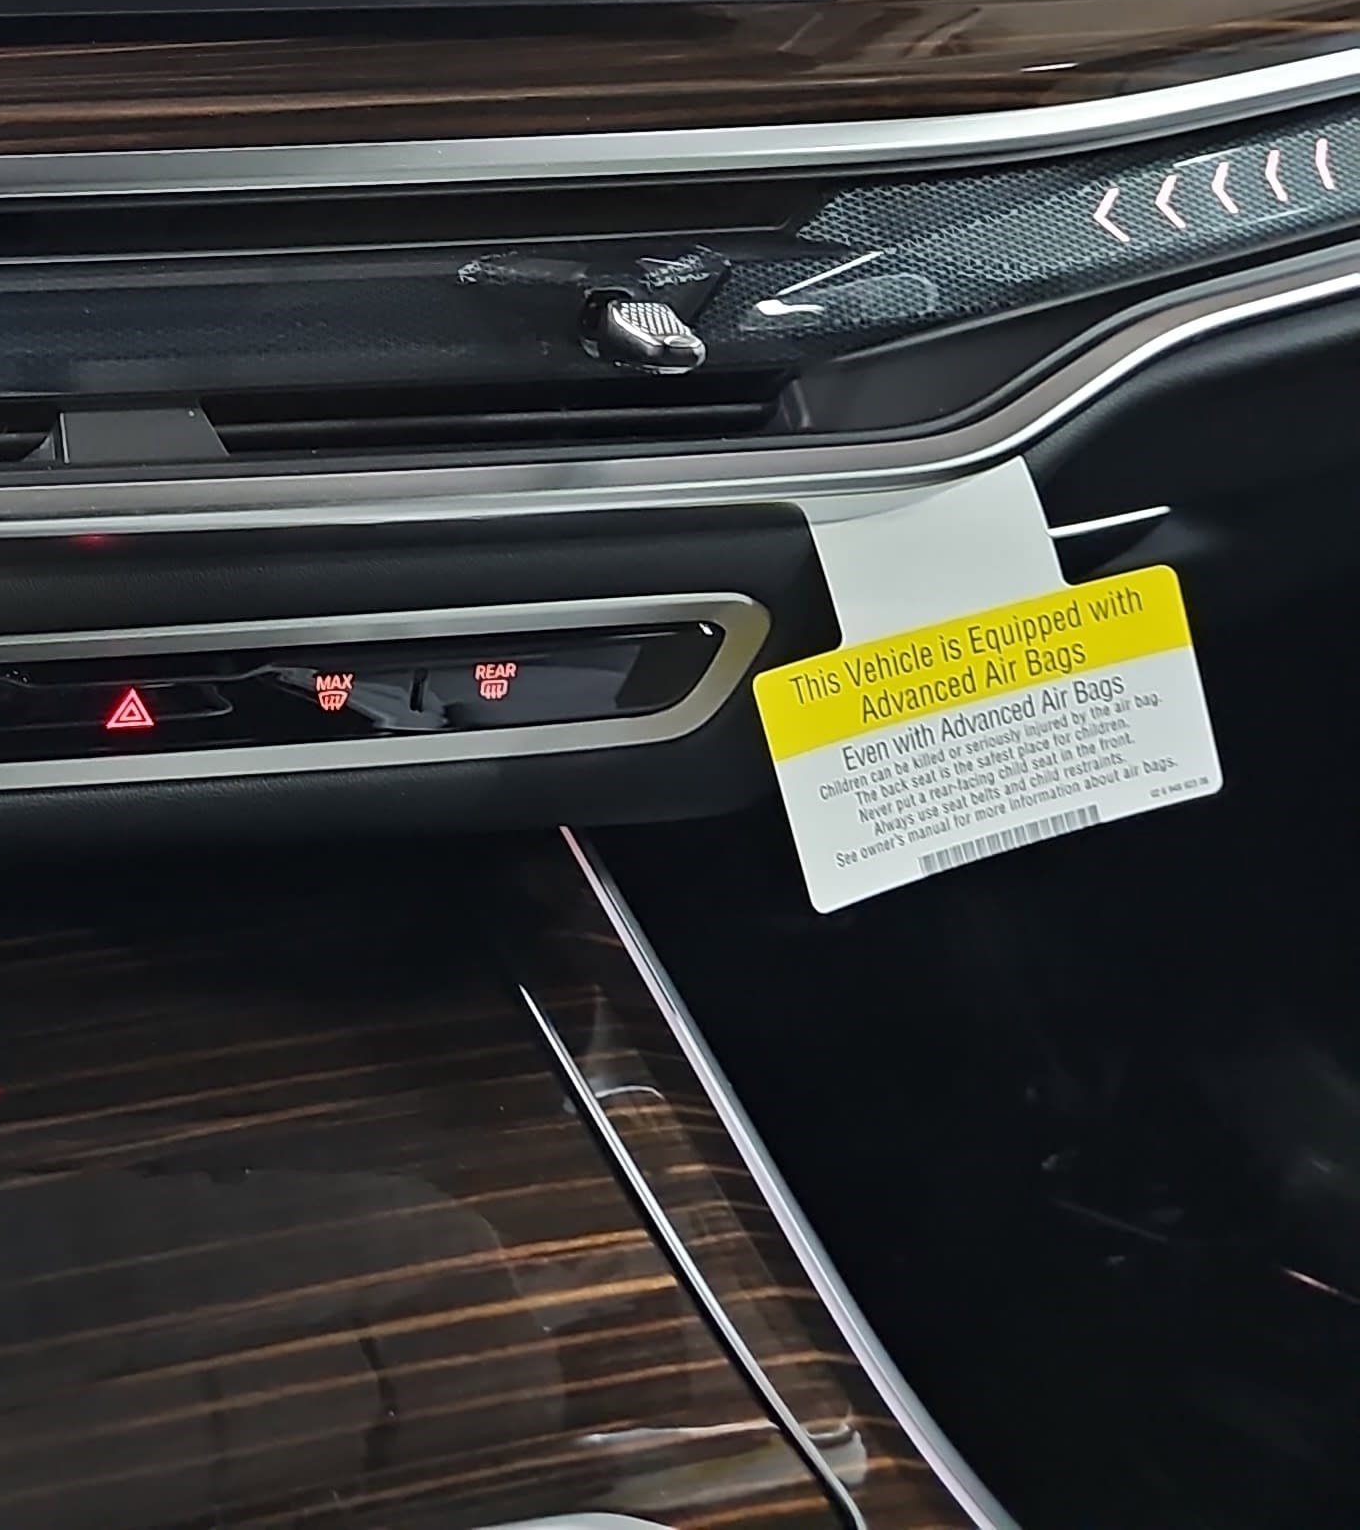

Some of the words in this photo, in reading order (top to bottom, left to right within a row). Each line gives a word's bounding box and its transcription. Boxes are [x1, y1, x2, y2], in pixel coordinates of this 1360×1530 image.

[316, 674, 353, 691] MAX
[476, 663, 517, 680] REAR
[789, 669, 841, 704] This
[844, 643, 933, 687] Vehicle
[939, 635, 962, 662] is
[967, 599, 1082, 654] Equipped
[1087, 587, 1143, 622] with
[862, 665, 976, 723] Advanced
[986, 657, 1016, 688] Air
[1024, 643, 1086, 676] Bags
[819, 775, 868, 800] Children
[870, 767, 892, 783] can
[894, 762, 909, 775] be
[912, 749, 945, 769] killed
[948, 746, 961, 759] or
[965, 728, 1020, 755] seriously
[1023, 713, 1068, 737] injured
[1070, 711, 1086, 725] by
[1089, 705, 1110, 719] the
[1115, 700, 1130, 713] air
[1134, 693, 1162, 708] bag.
[842, 741, 890, 771] Even
[892, 723, 935, 755] with
[941, 693, 1036, 742] Advanced
[1042, 687, 1067, 714] Air
[1073, 676, 1124, 704] Bags
[854, 789, 877, 805] The
[879, 778, 909, 798] back
[911, 769, 937, 788] seat
[940, 767, 951, 779] is
[953, 760, 973, 775] the
[976, 747, 1015, 768] safest
[1017, 739, 1050, 760] place
[1052, 733, 1071, 746] for
[1074, 718, 1130, 741] children.
[836, 851, 857, 867] See
[860, 833, 905, 859] owner's
[905, 817, 951, 843] manual
[953, 813, 970, 828] for
[974, 803, 1005, 821] more
[1008, 781, 1081, 811] information
[1084, 769, 1120, 790] about
[1123, 765, 1138, 779] air
[1142, 757, 1178, 774] bags.
[858, 802, 892, 823] Never
[895, 793, 917, 814] put
[919, 793, 927, 803] a
[929, 771, 995, 800] rear-facing
[998, 758, 1028, 780] child
[1031, 752, 1058, 770] seat
[1060, 749, 1073, 761] in
[1075, 743, 1096, 758] the
[1098, 732, 1135, 751] front.
[874, 813, 915, 836] Always
[917, 806, 939, 821] use
[941, 795, 968, 814] seat
[969, 787, 1001, 805] belts
[1004, 777, 1027, 795] and
[1029, 768, 1059, 788] child
[1063, 752, 1125, 778] restraints.
